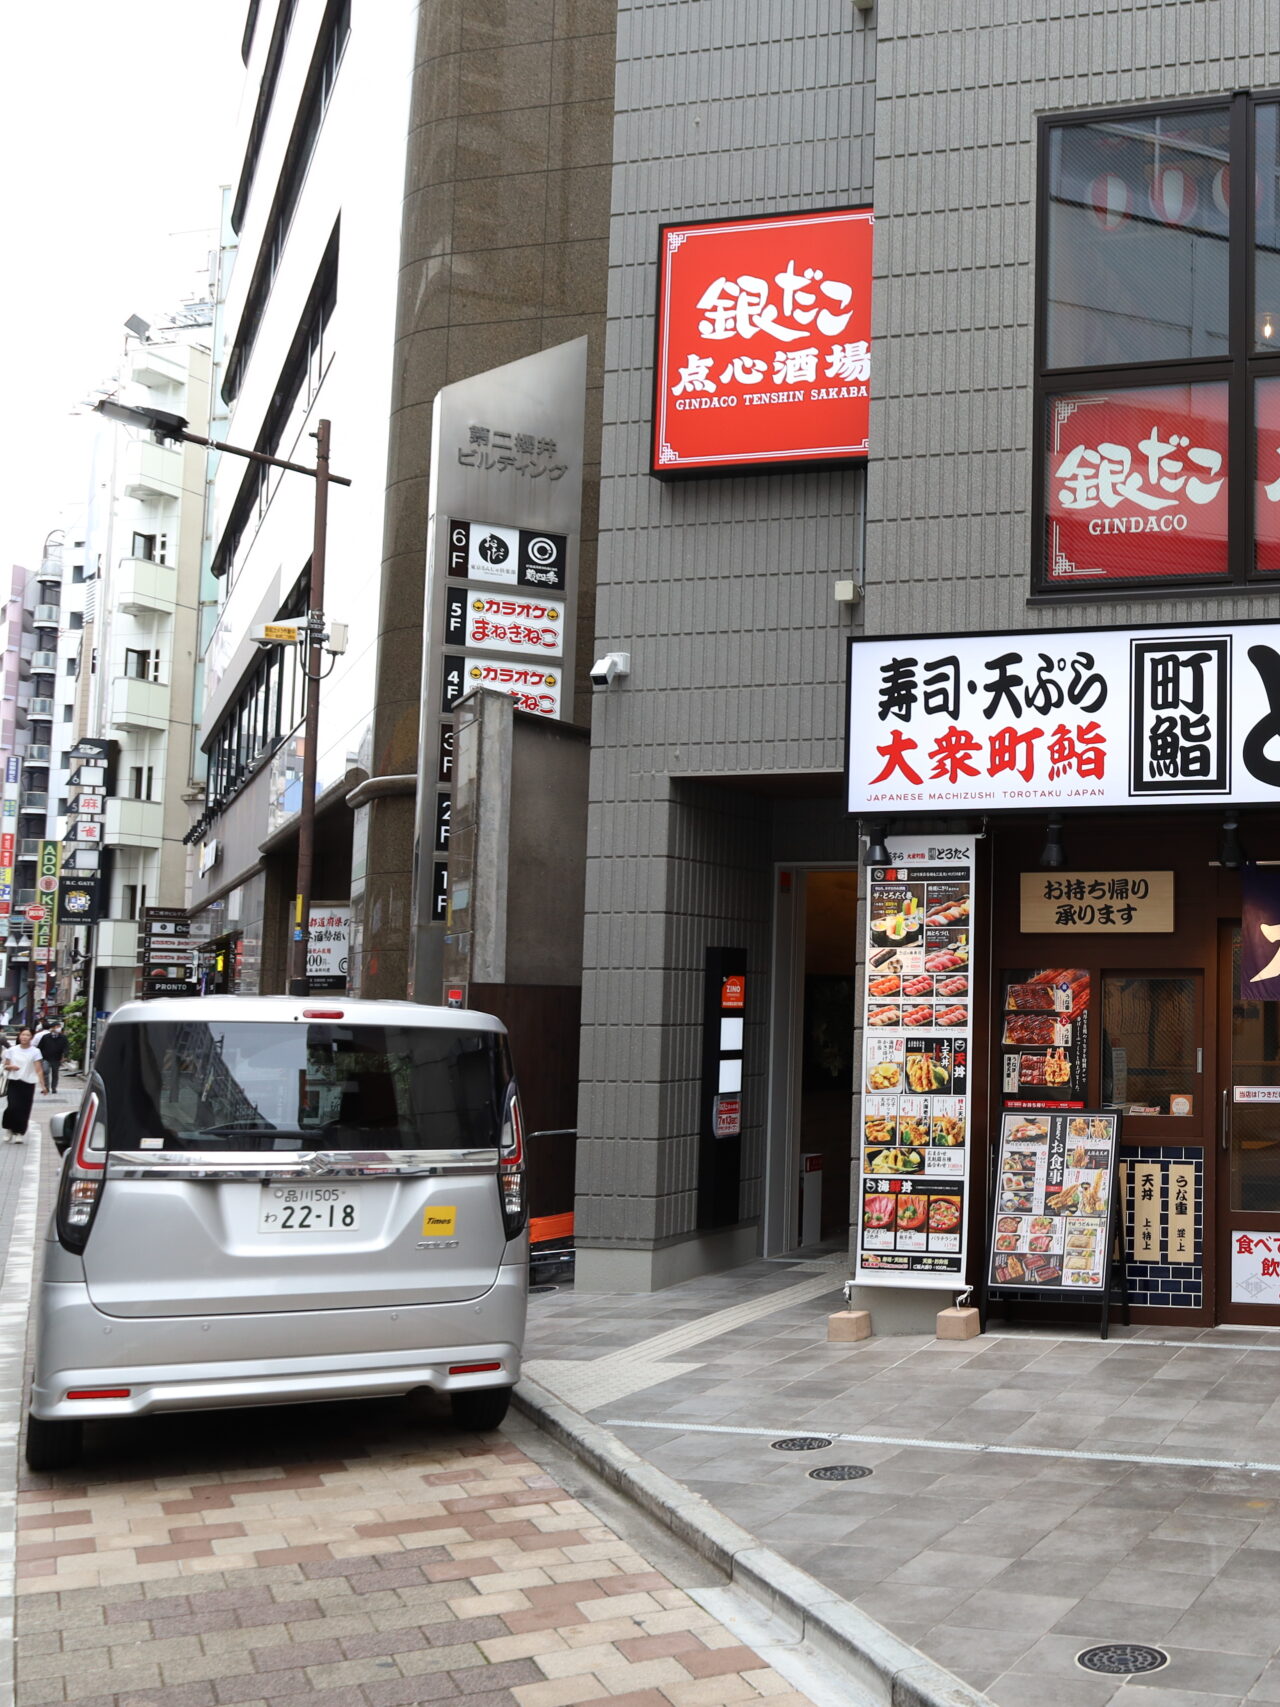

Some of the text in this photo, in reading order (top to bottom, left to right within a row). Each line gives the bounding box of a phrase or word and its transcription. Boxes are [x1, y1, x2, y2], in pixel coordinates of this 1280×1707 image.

[695, 259, 854, 342] 銀だこ
[671, 340, 871, 396] 点心酒場
[676, 385, 868, 411] GINDACO TENSHIN SAKABA
[458, 448, 568, 480] ビルディング
[1054, 425, 1224, 509] 銀だこ
[1088, 514, 1188, 536] GINDACO
[485, 599, 547, 619] カラオケ
[472, 618, 559, 648] まねきねこ
[482, 666, 545, 686] カラオケ
[877, 651, 1108, 723] 寿司・天ぷら
[1148, 652, 1212, 778] 町鮨
[867, 720, 1107, 786] 大衆町鮨
[866, 788, 1106, 802] JAPANESE MACHIZUSHI TOROTAKU JAPAN
[936, 847, 970, 860] とろたく
[1043, 878, 1149, 901] お持ち帰り
[1055, 903, 1138, 926] 承ります
[1048, 1141, 1064, 1185] お食事
[1174, 1175, 1188, 1215] うな重
[264, 1204, 355, 1229] わ 22-18
[426, 1217, 452, 1225] Times
[1141, 1174, 1154, 1251] 天丼 上・特上
